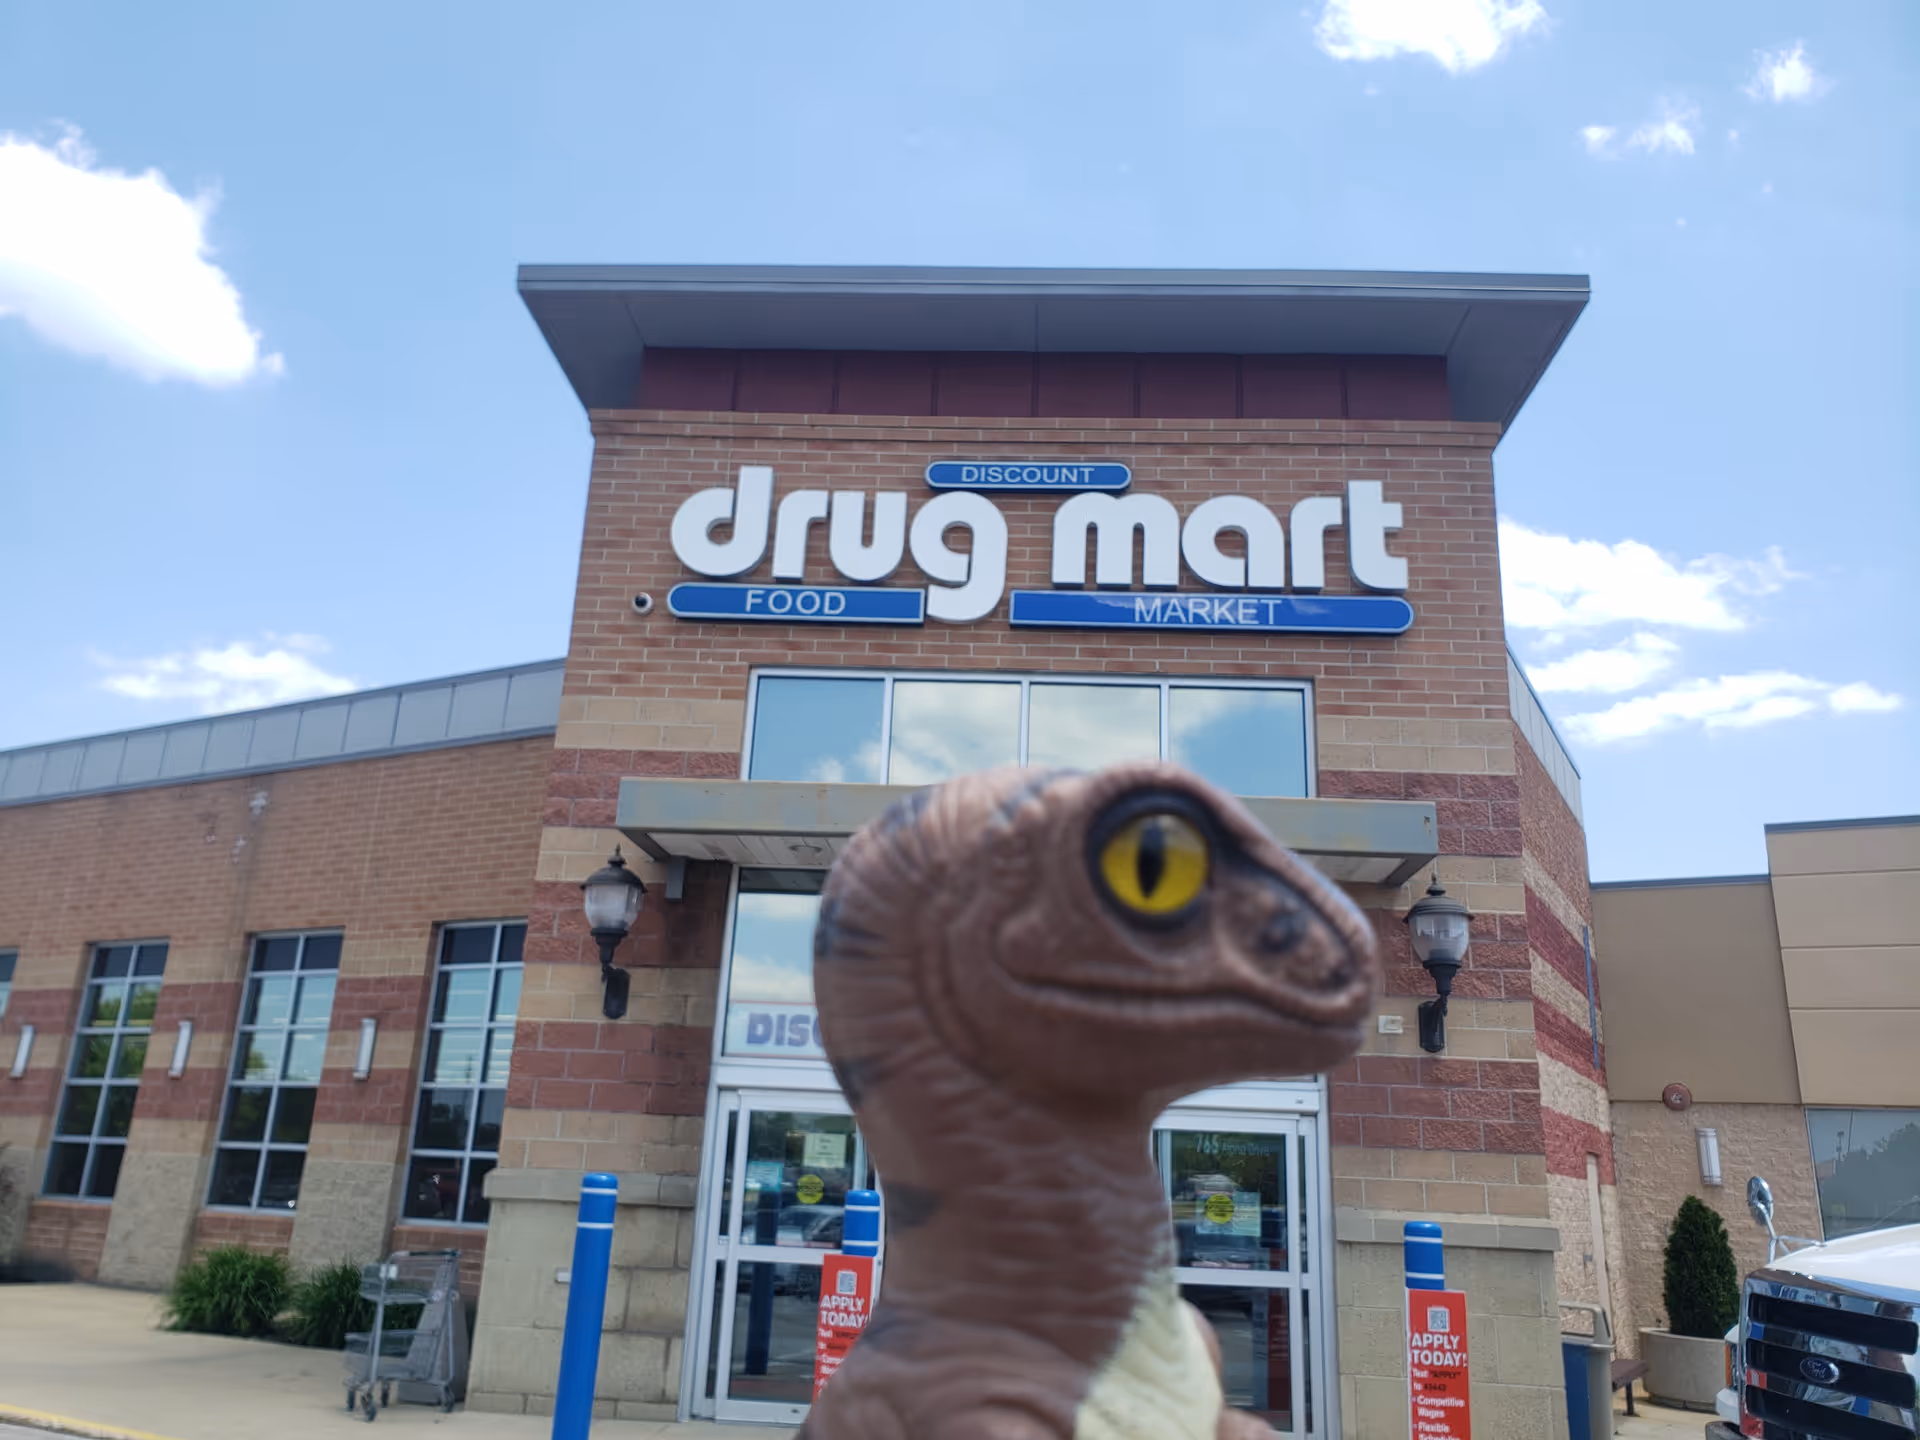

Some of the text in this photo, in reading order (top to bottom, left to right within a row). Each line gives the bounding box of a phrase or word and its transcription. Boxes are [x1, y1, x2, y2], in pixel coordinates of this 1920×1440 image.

[961, 466, 1095, 484] DISCOUNT
[670, 465, 1409, 623] drug mart
[745, 589, 847, 615] FOOD
[1134, 597, 1282, 625] MARKET
[820, 1295, 865, 1312] APPLY
[1411, 1333, 1460, 1350] APPLY
[1412, 1349, 1468, 1368] TODAY!
[1417, 1394, 1466, 1408] Competitive
[1417, 1406, 1445, 1419] Wages
